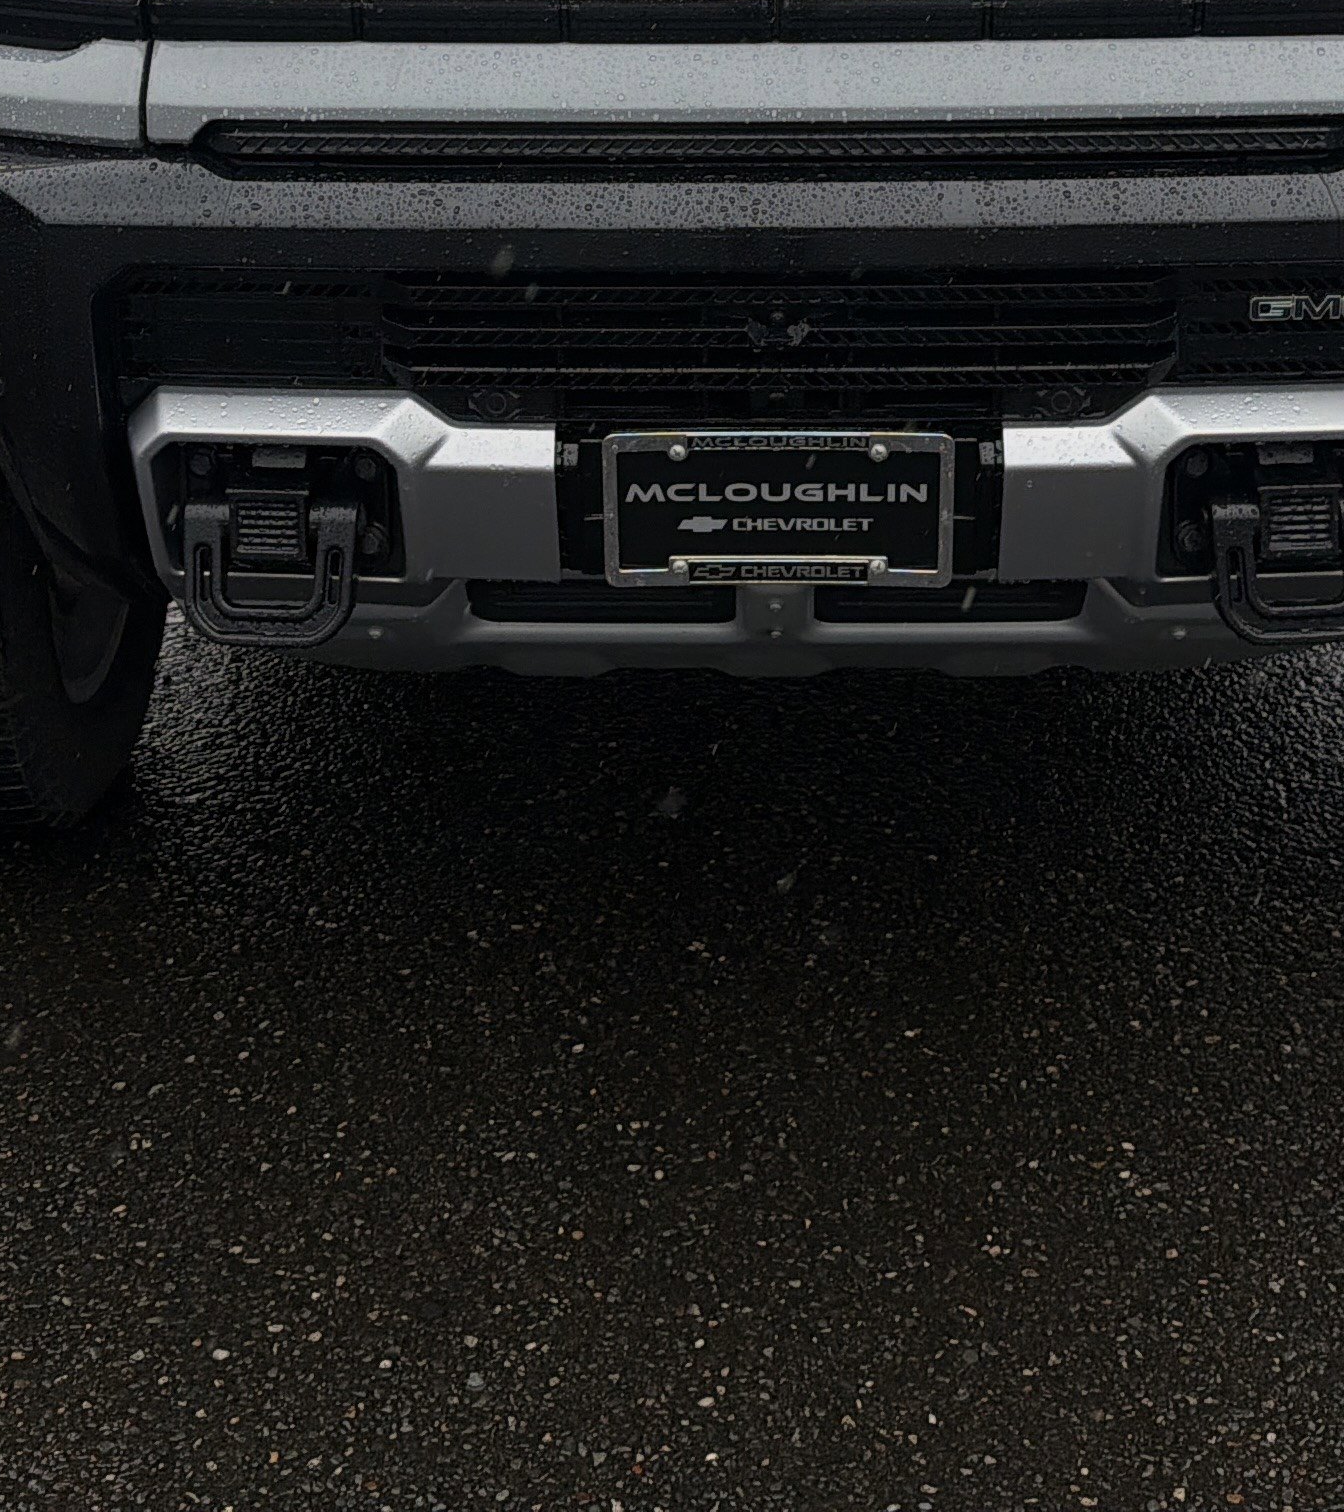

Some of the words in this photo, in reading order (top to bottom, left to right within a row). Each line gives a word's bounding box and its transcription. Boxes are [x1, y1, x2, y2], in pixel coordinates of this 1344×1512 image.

[690, 436, 867, 449] MCLOUGHLIN
[624, 482, 929, 504] MCLOUGHLIN
[732, 517, 874, 532] CHEVROLET
[740, 564, 865, 580] CHEVROLET
